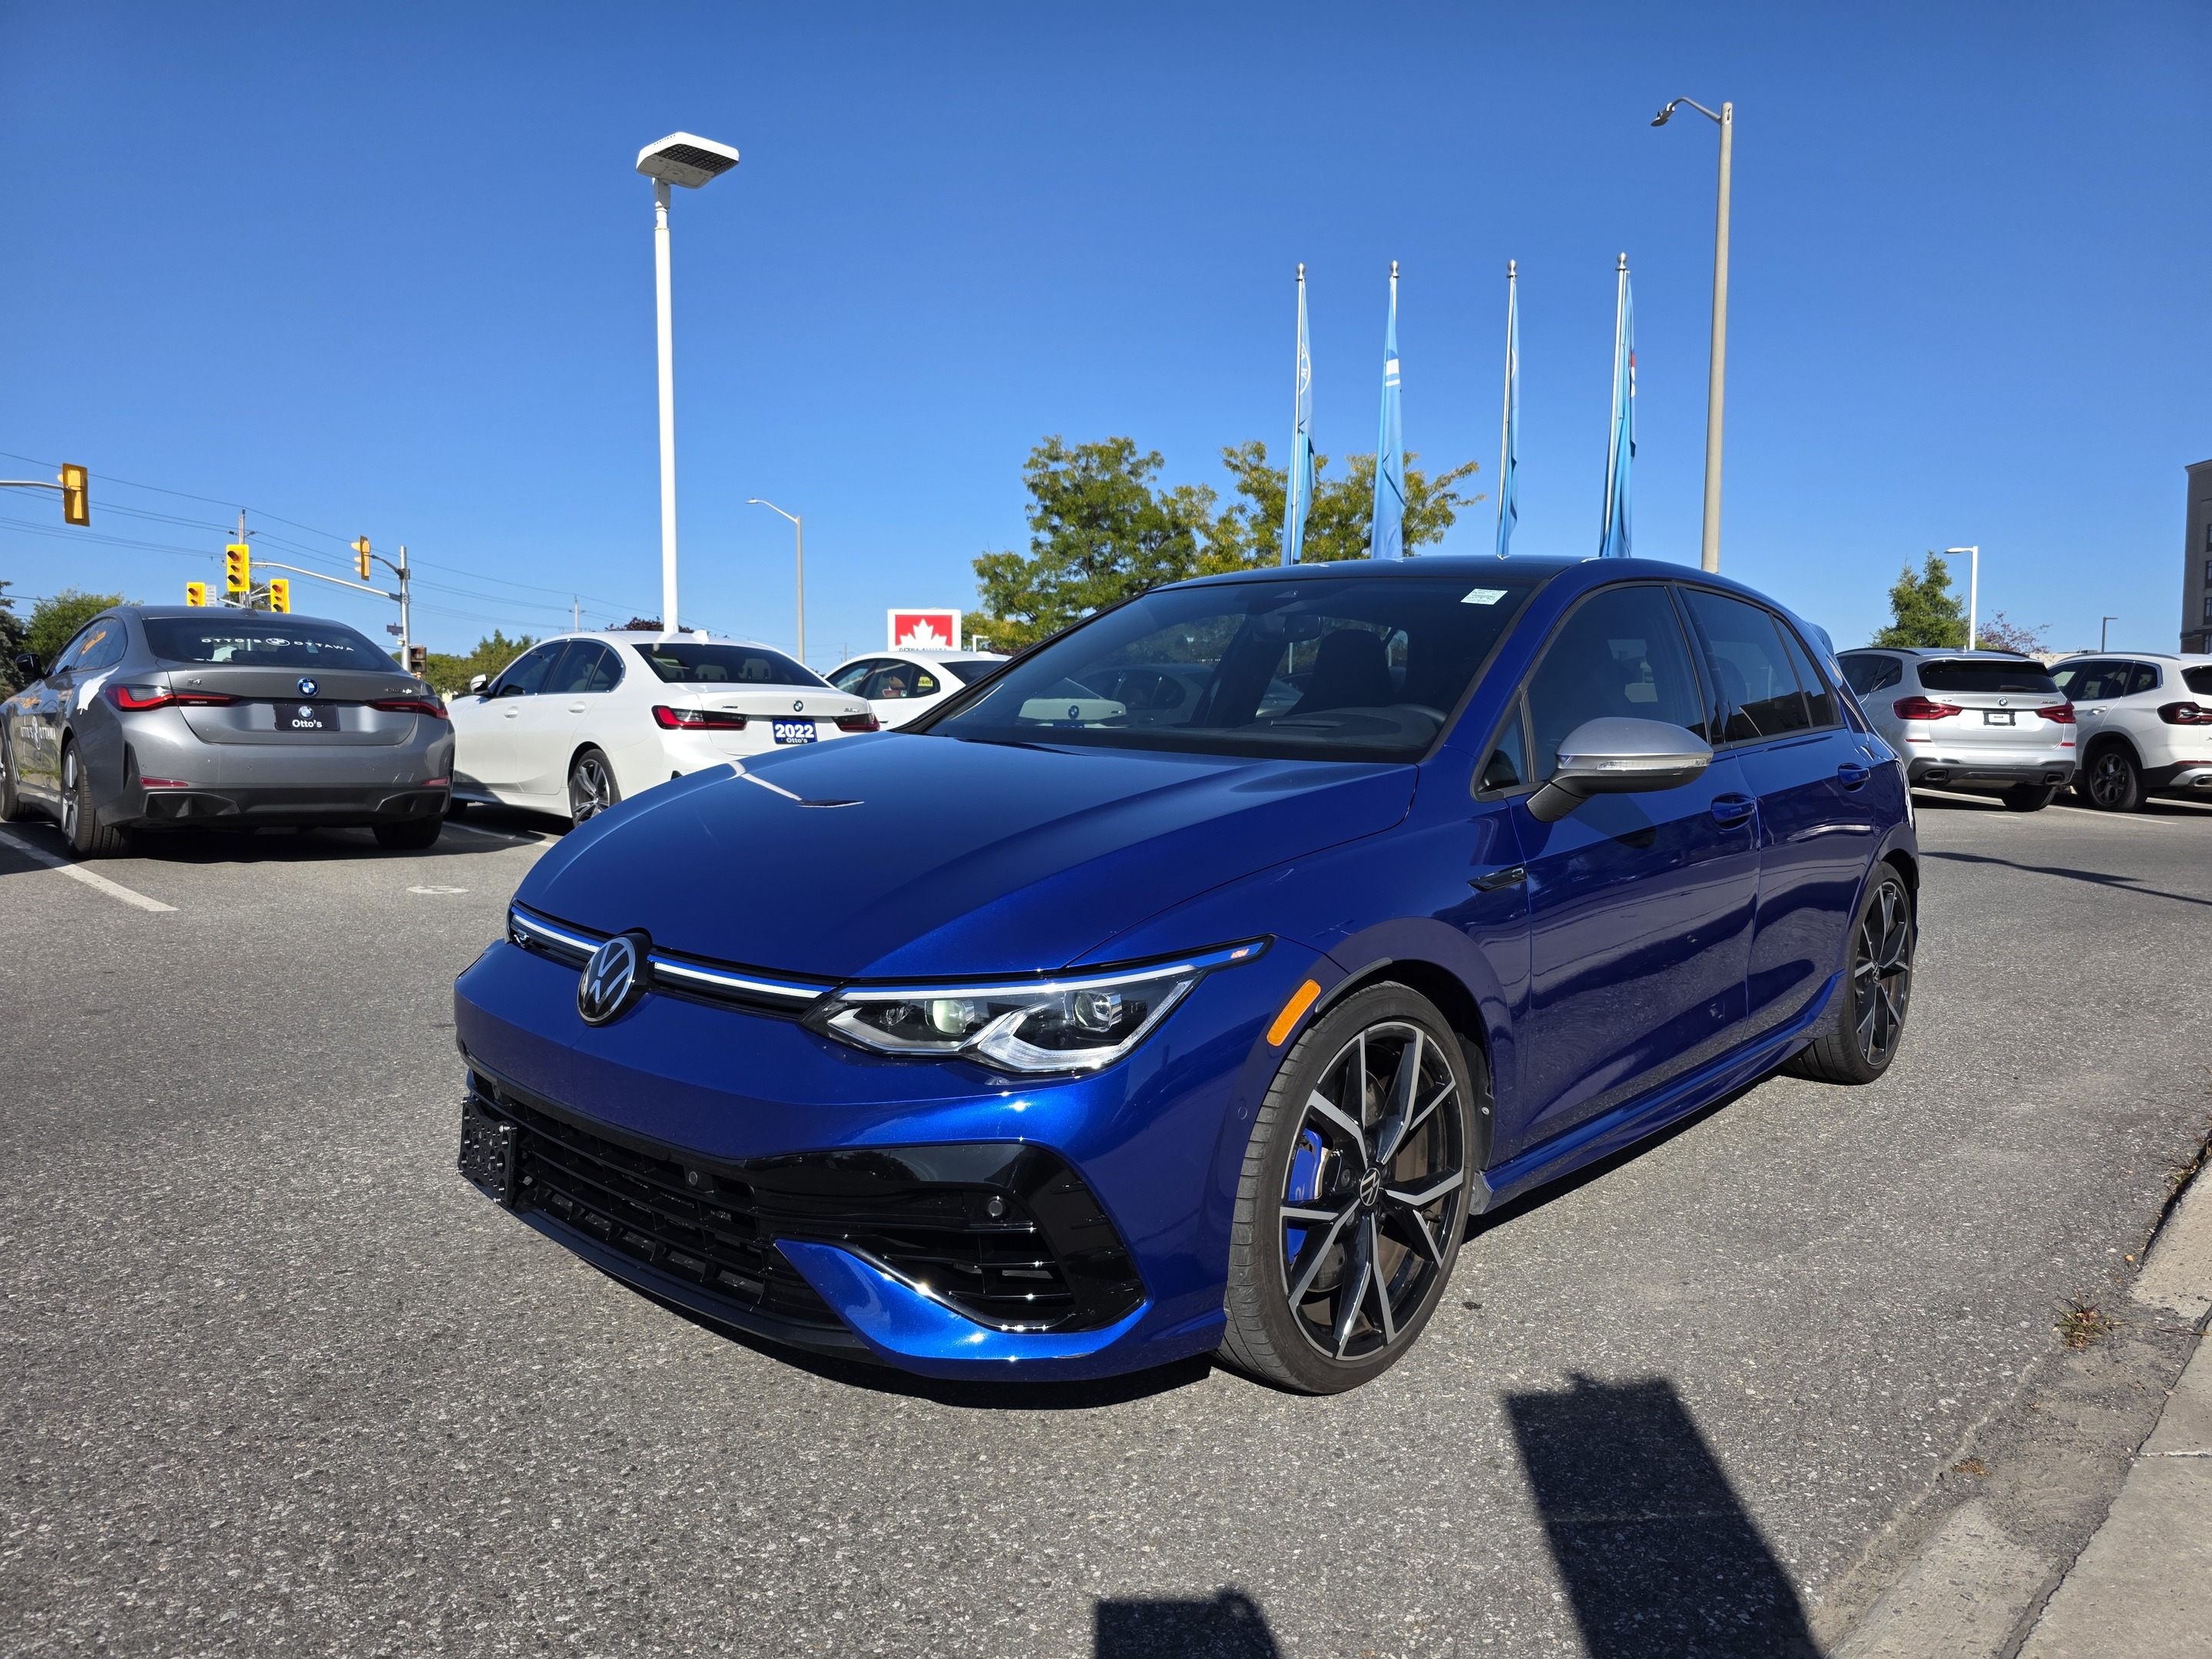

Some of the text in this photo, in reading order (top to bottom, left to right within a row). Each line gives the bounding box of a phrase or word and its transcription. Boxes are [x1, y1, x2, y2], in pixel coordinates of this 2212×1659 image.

[293, 641, 355, 651] OTTAWA
[292, 719, 323, 728] Otto's
[775, 724, 815, 738] 2022
